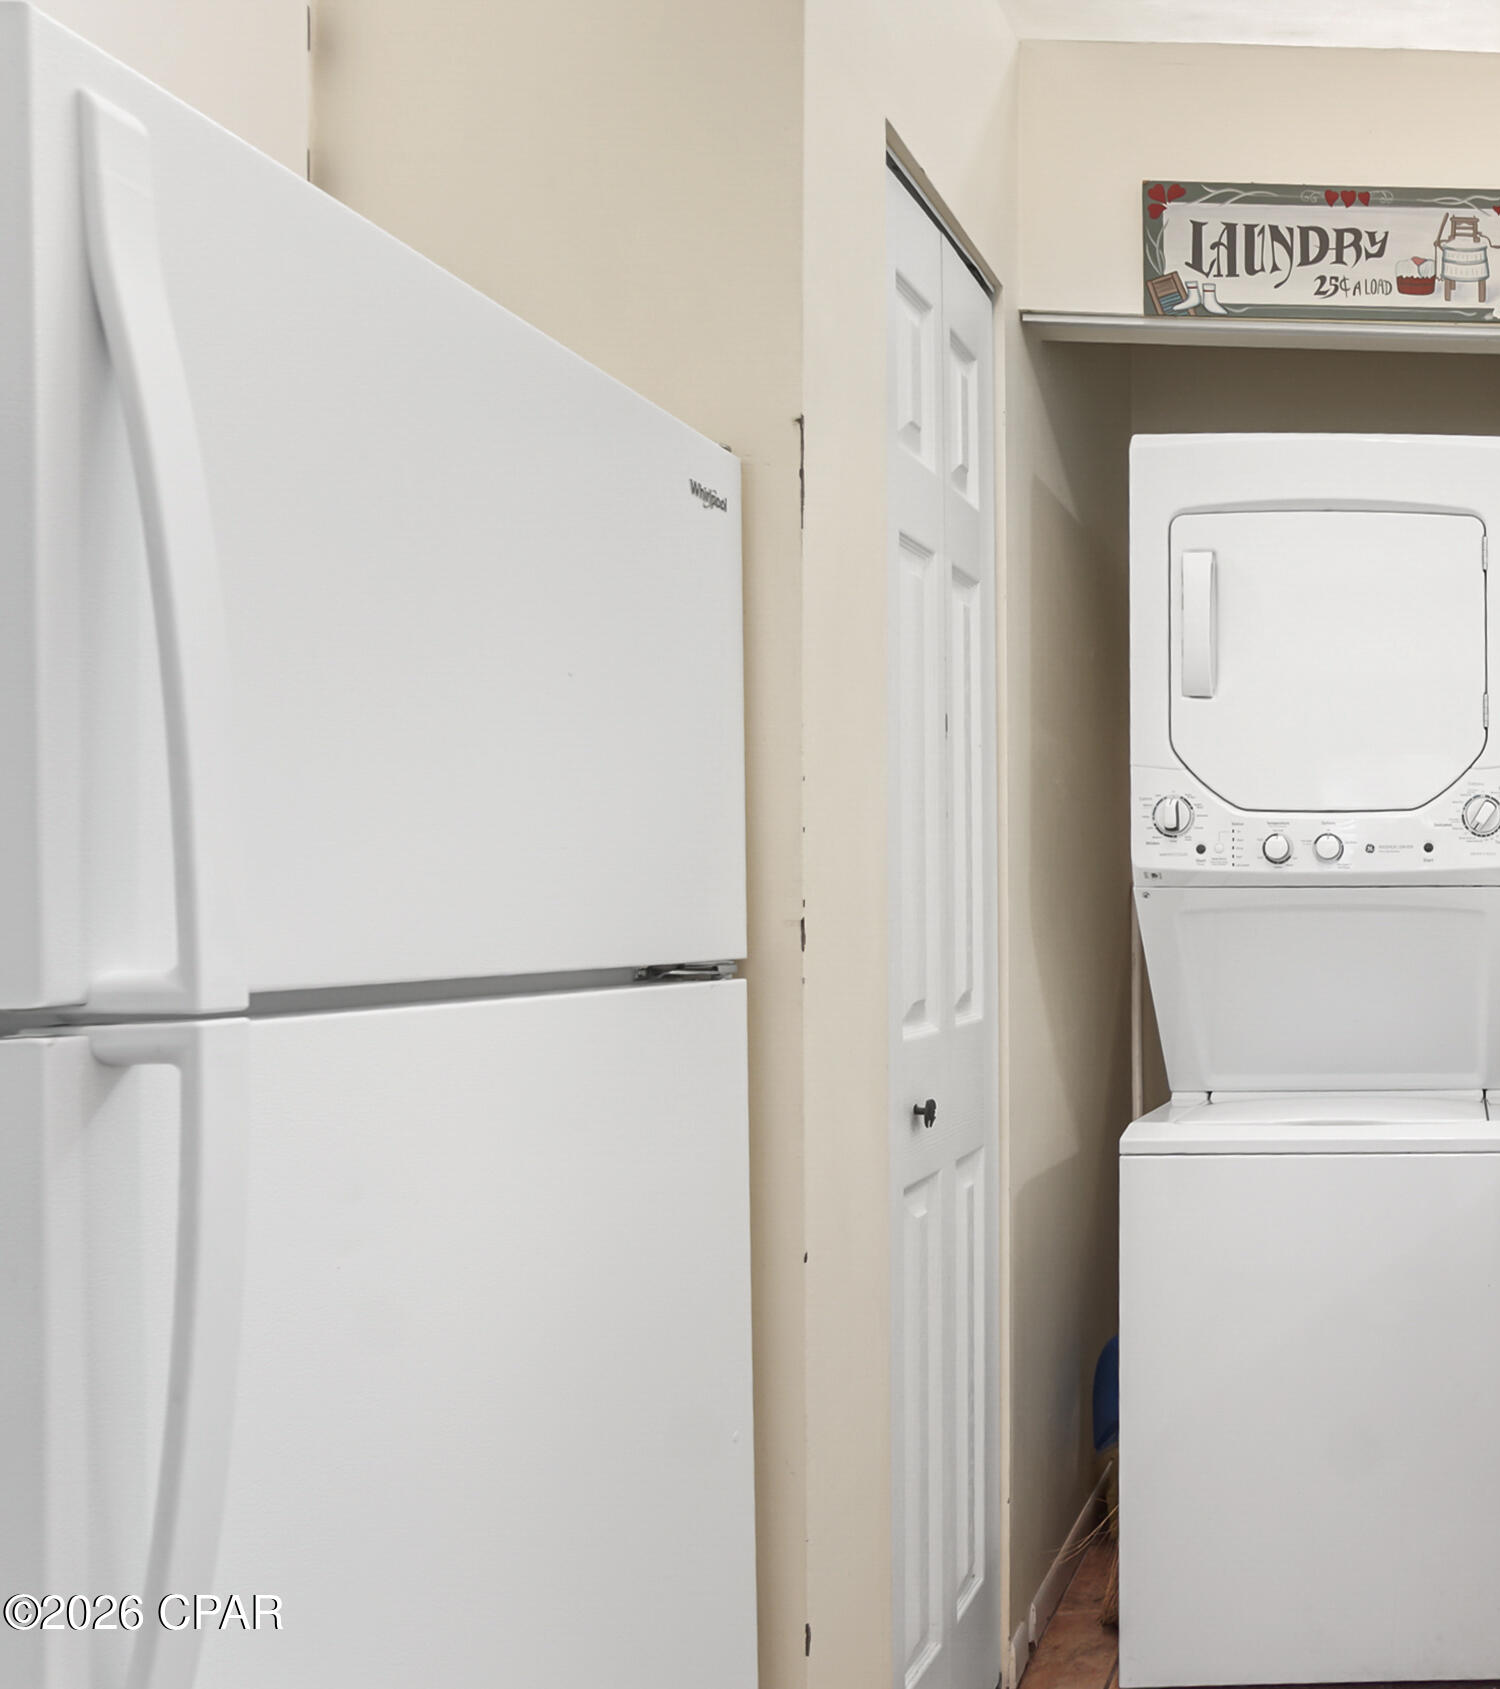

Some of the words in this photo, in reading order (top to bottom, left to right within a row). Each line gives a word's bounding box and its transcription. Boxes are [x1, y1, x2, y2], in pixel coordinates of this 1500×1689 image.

[1184, 218, 1390, 290] LAUNDRY
[1352, 280, 1362, 297] A
[1364, 278, 1393, 296] LOAD
